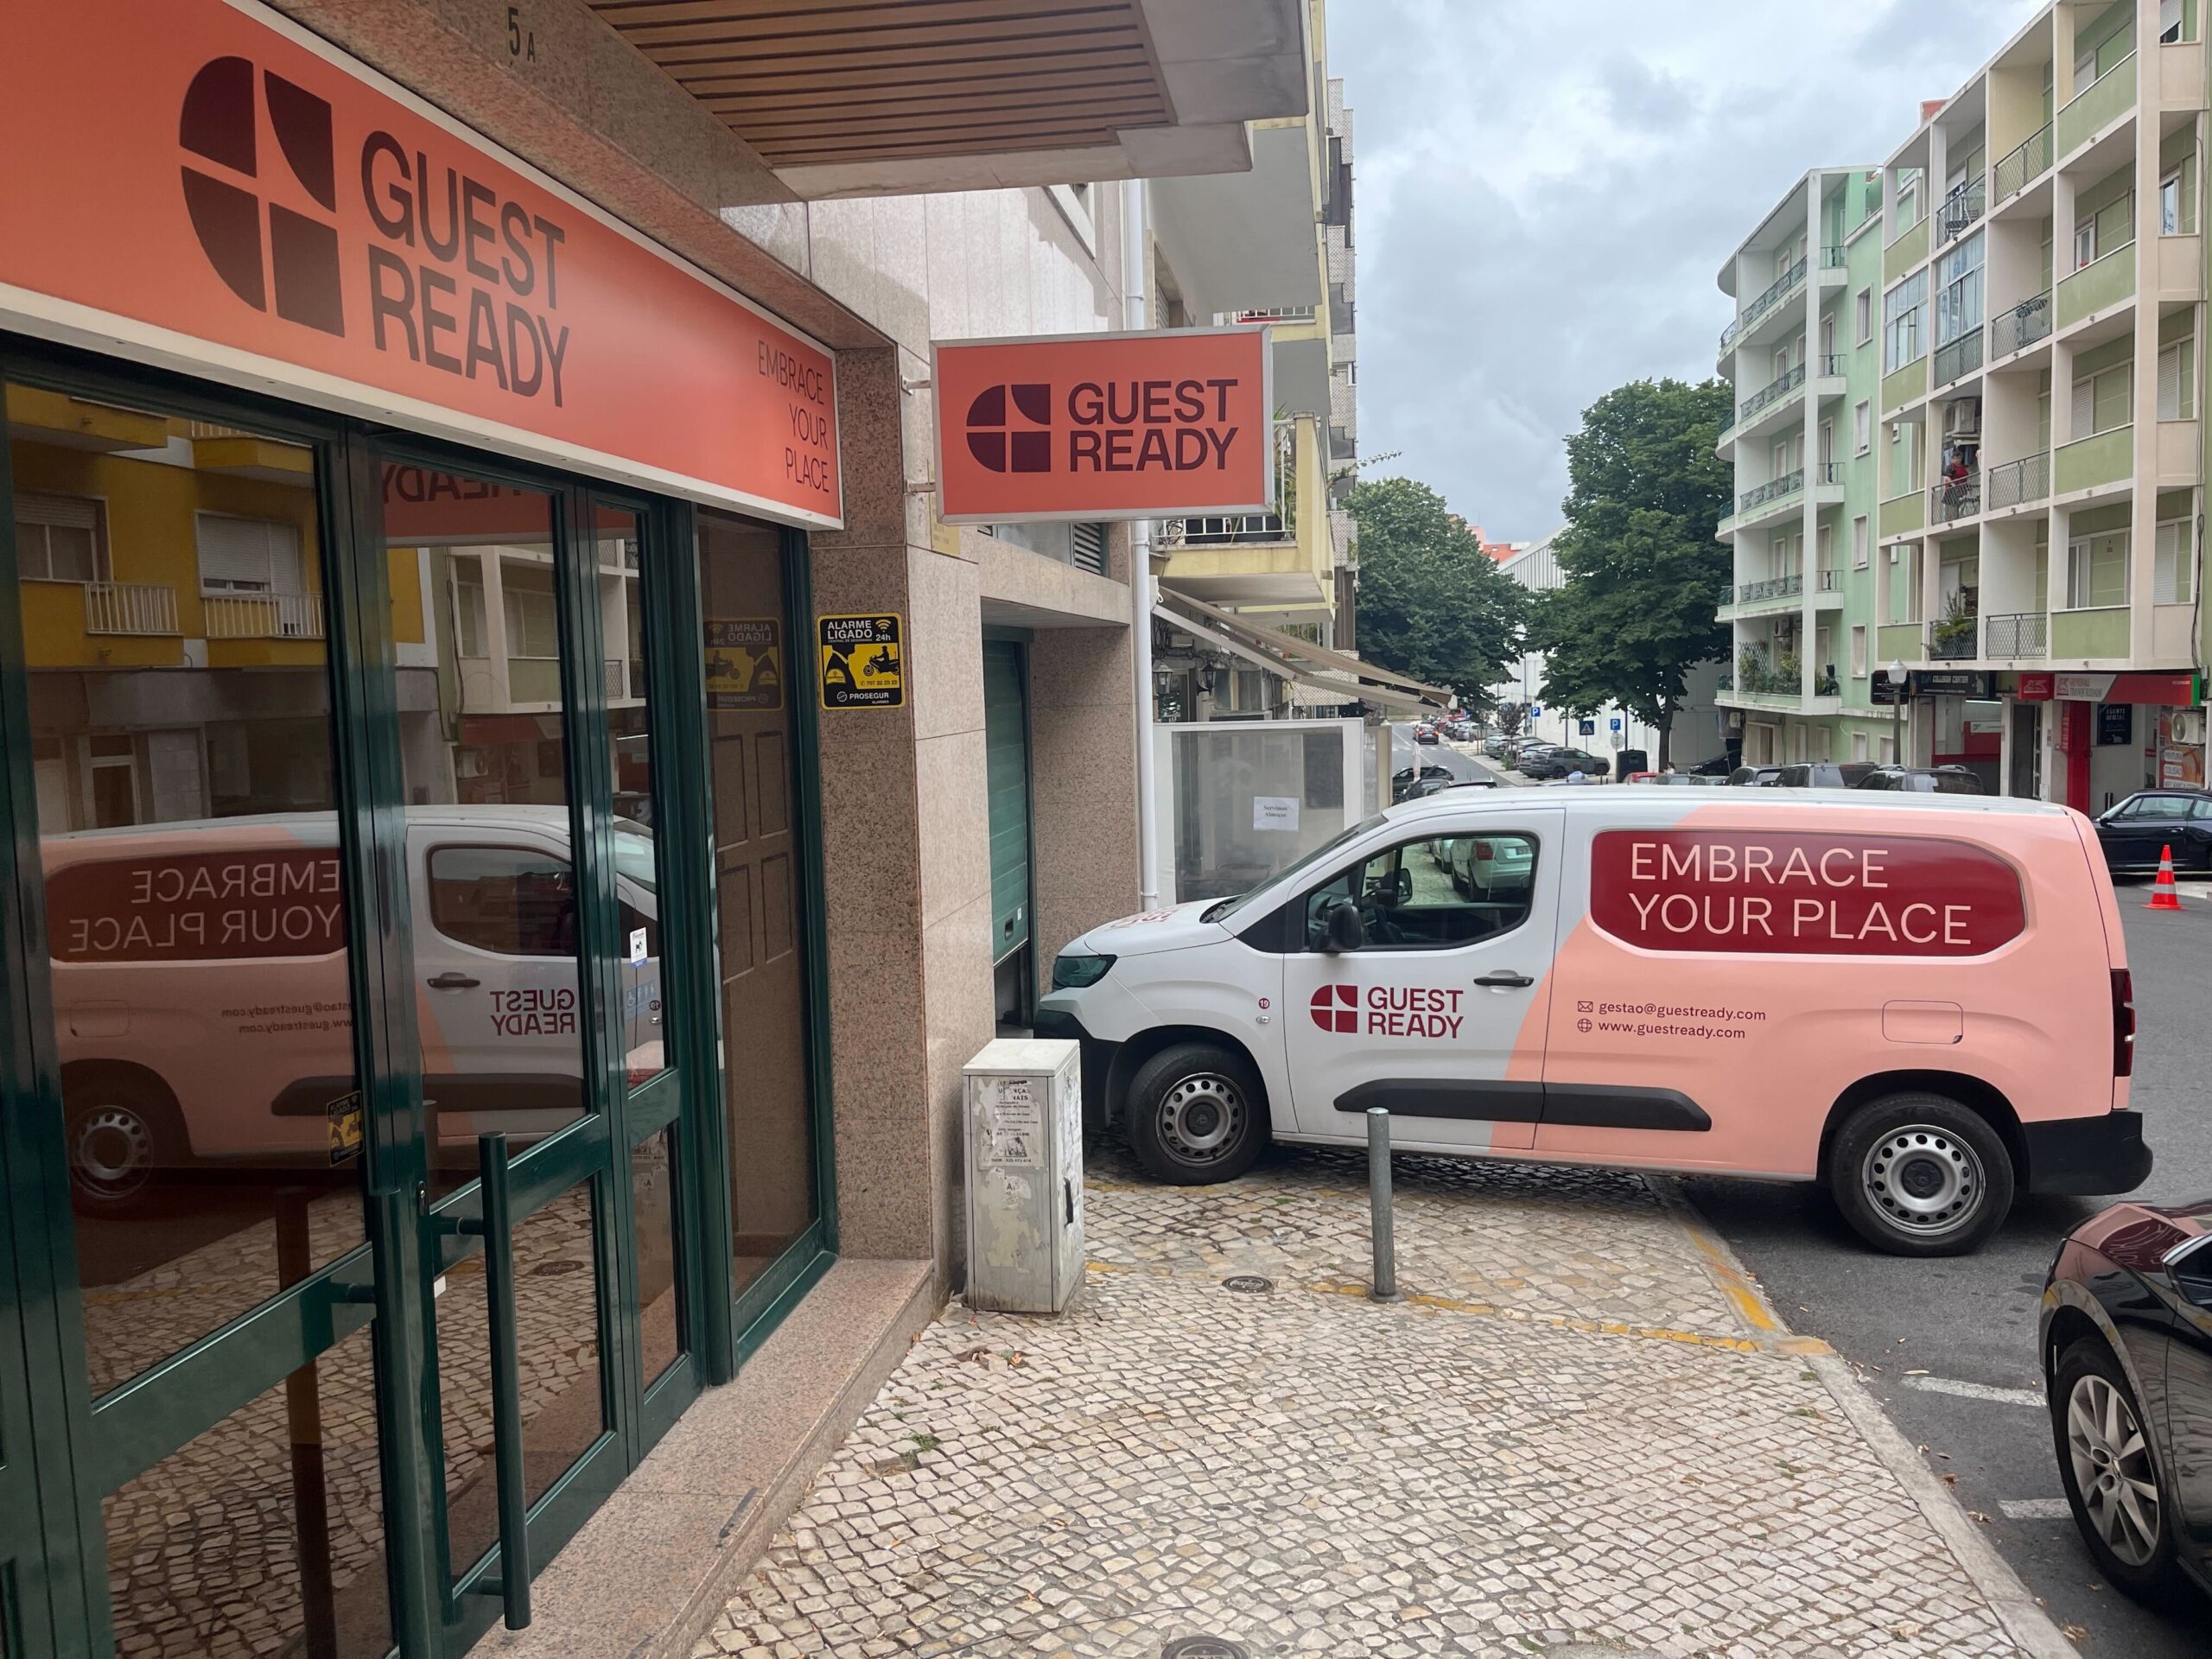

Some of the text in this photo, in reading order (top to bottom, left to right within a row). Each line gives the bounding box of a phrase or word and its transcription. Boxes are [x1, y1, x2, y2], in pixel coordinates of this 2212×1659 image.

[508, 6, 536, 63] 5 A
[360, 130, 565, 310] GUEST
[367, 243, 569, 409] READY
[758, 339, 824, 406] EMBRACE
[1068, 378, 1238, 425] GUEST
[788, 402, 829, 450] YOUR
[785, 447, 830, 493] PLACE
[1070, 427, 1239, 473] READY
[828, 620, 872, 630] ALARME
[828, 628, 873, 639] LIGADO
[1631, 842, 1889, 888] EMBRACE
[1628, 893, 1972, 945] YOUR PLACE
[1260, 1000, 1269, 1008] 19
[1367, 986, 1464, 1014] GUEST
[1599, 1002, 1766, 1021] gestao@guestready.com
[1368, 1012, 1464, 1039] READY
[1599, 1021, 1745, 1039] www.guestready.com
